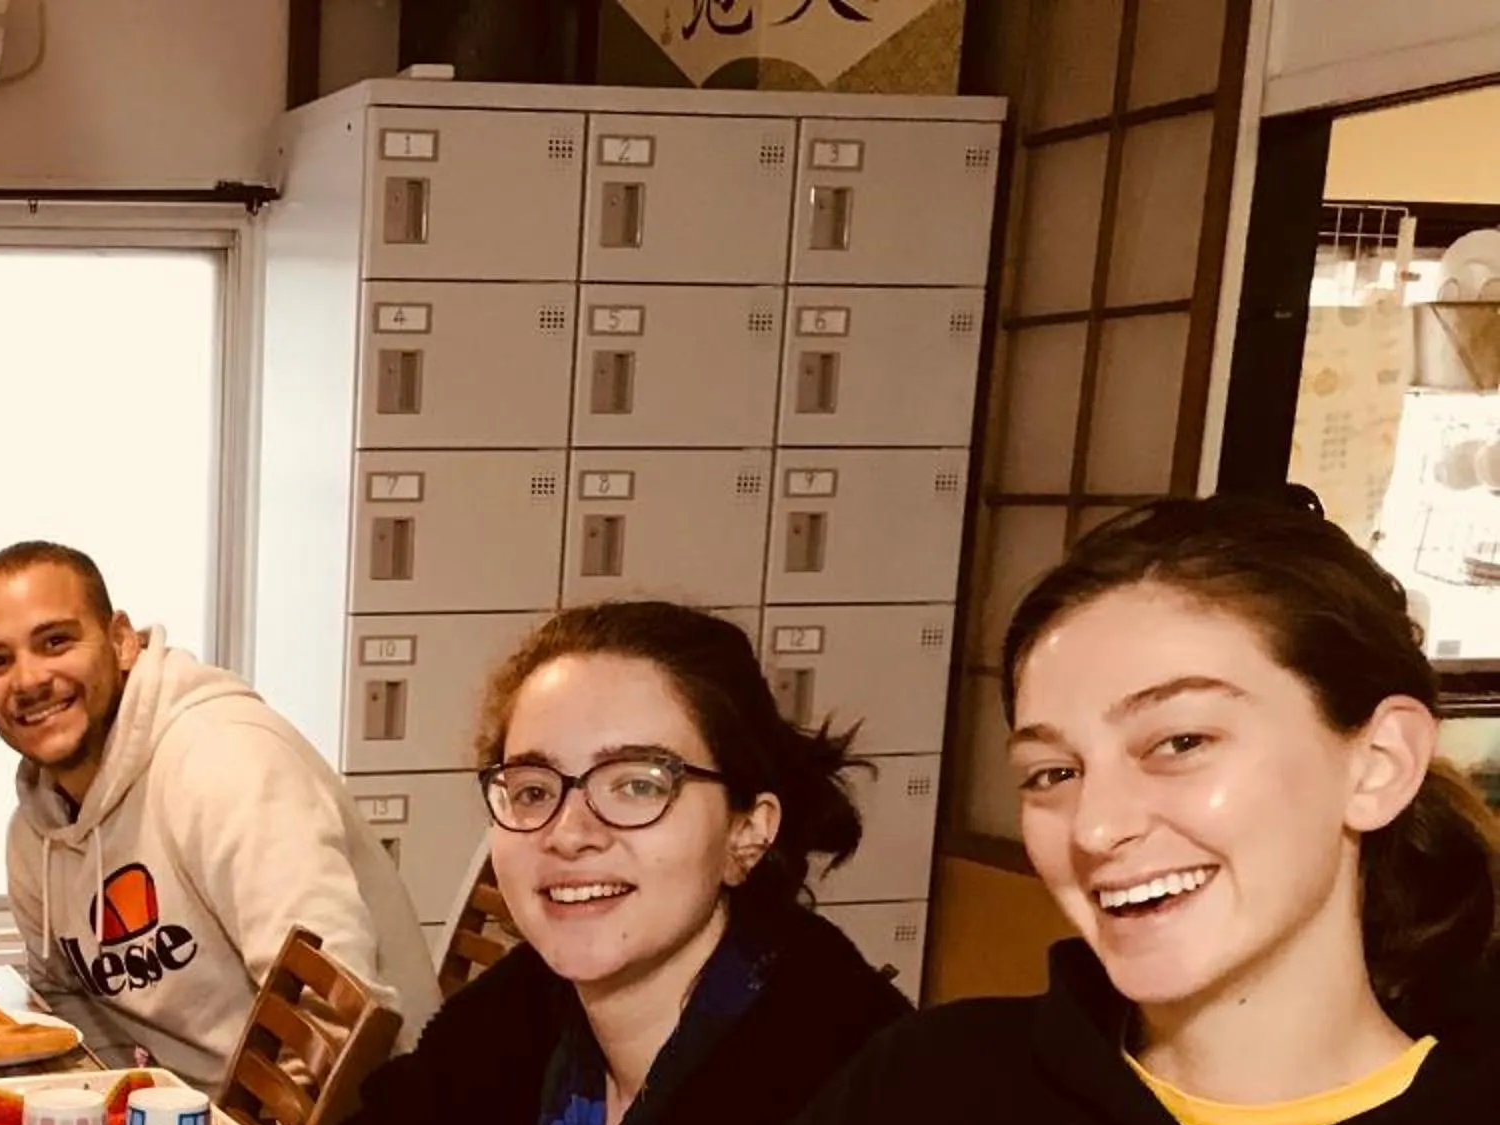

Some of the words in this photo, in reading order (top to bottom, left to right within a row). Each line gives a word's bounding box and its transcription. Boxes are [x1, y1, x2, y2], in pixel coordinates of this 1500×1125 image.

[618, 137, 631, 160] 2
[829, 144, 840, 163] 3
[393, 307, 406, 326] 4
[608, 309, 620, 330] 5
[815, 310, 827, 330] 6
[387, 475, 400, 496] 7
[598, 474, 610, 494] 8
[789, 628, 805, 647] 12
[379, 640, 397, 658] 10
